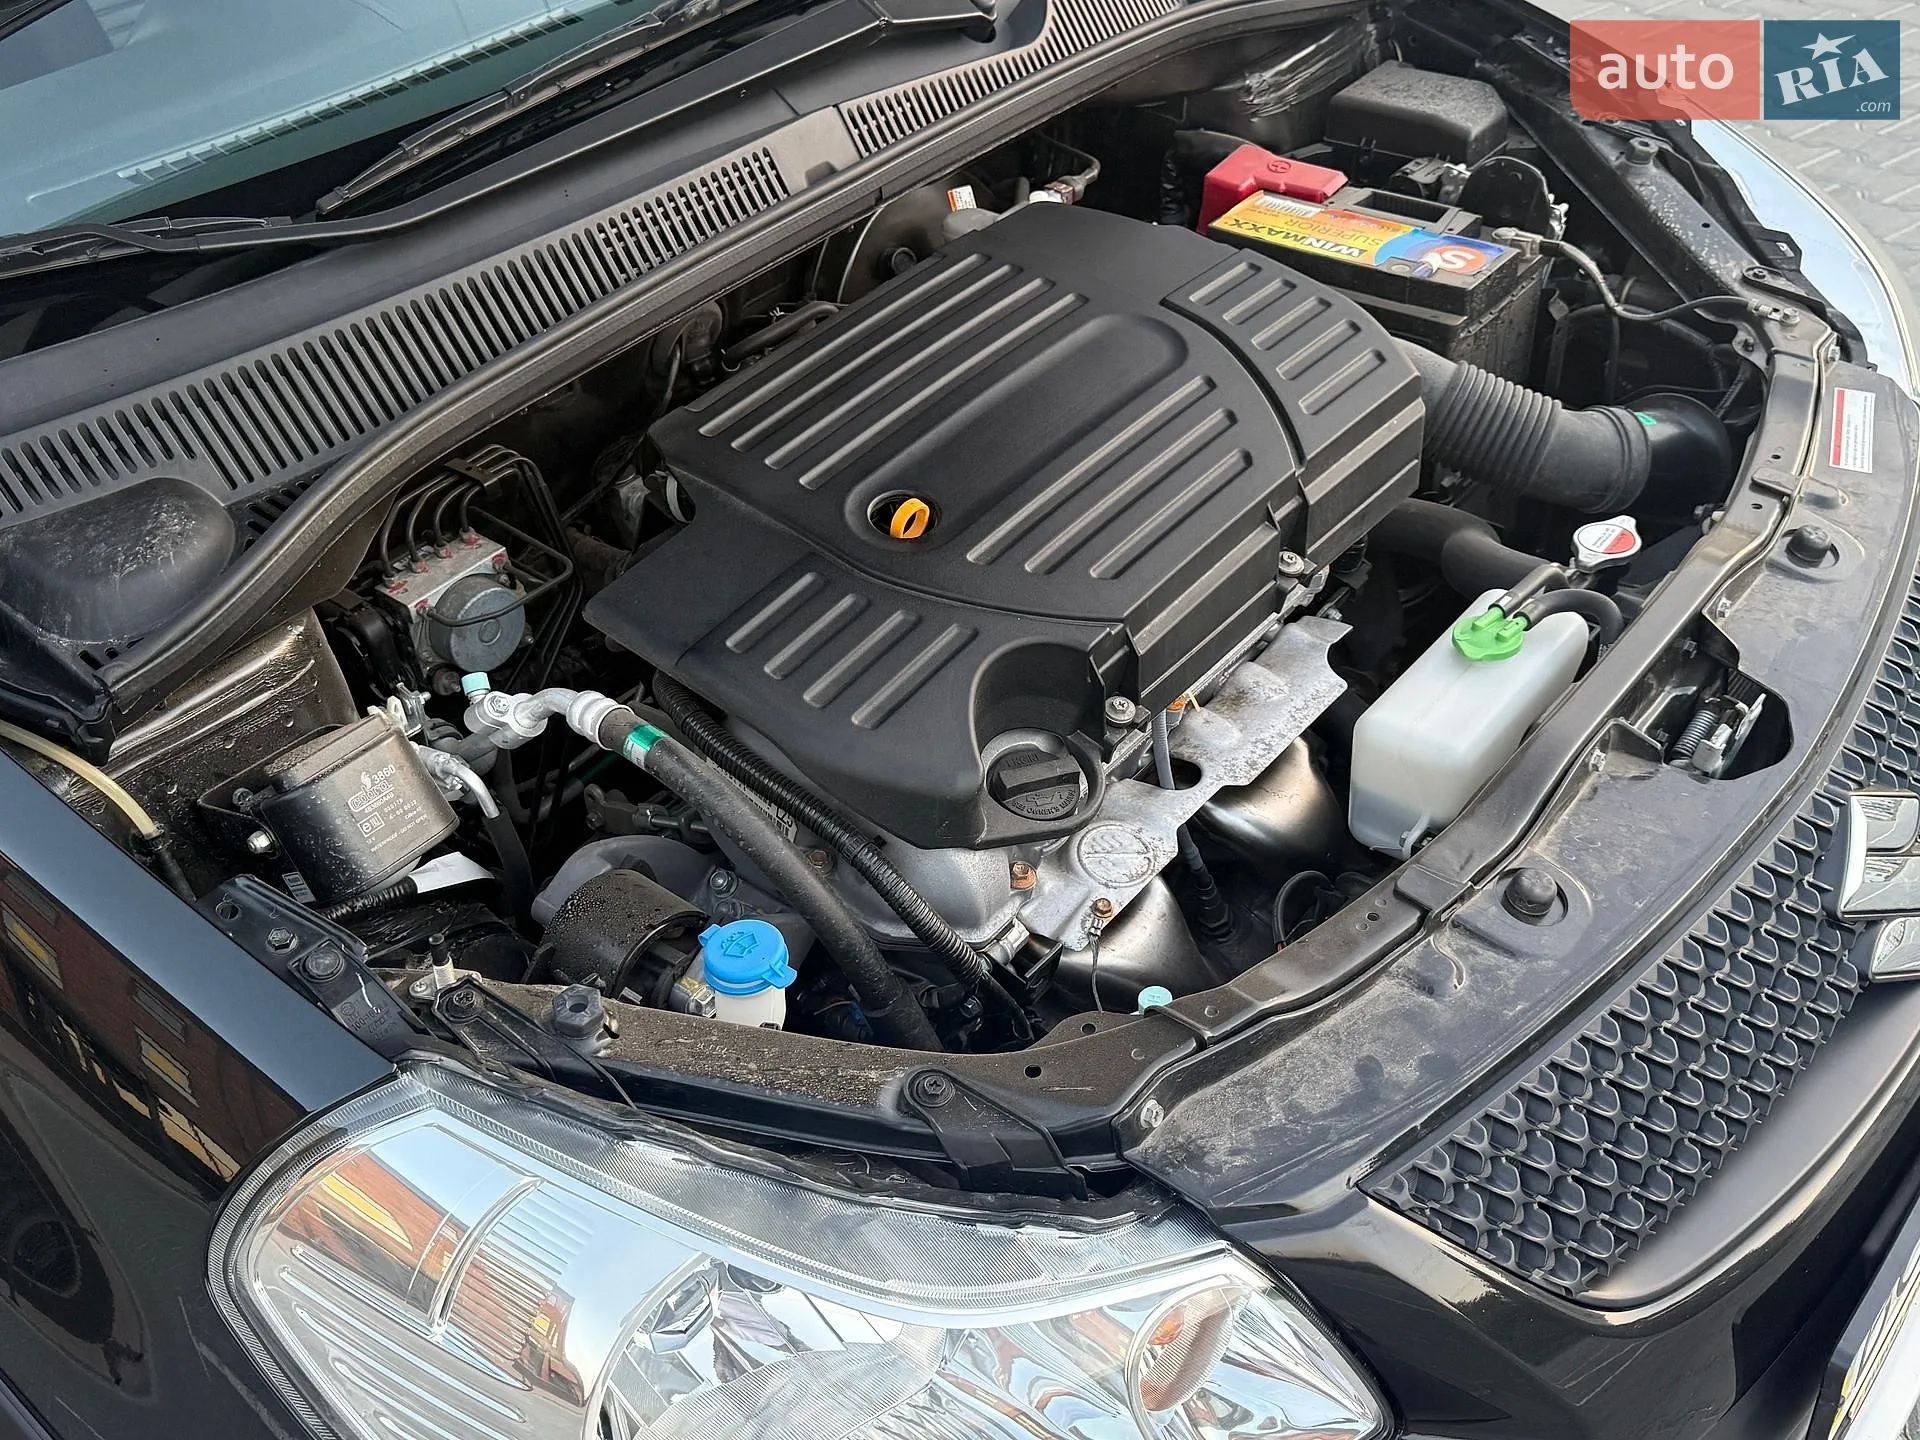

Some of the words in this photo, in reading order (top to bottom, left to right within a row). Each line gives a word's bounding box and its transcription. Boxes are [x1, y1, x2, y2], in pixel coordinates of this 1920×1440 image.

[1229, 217, 1368, 258] WINMAXX
[1284, 218, 1385, 246] SUPERIOR
[371, 764, 396, 784] 3860
[351, 779, 391, 809] cobra
